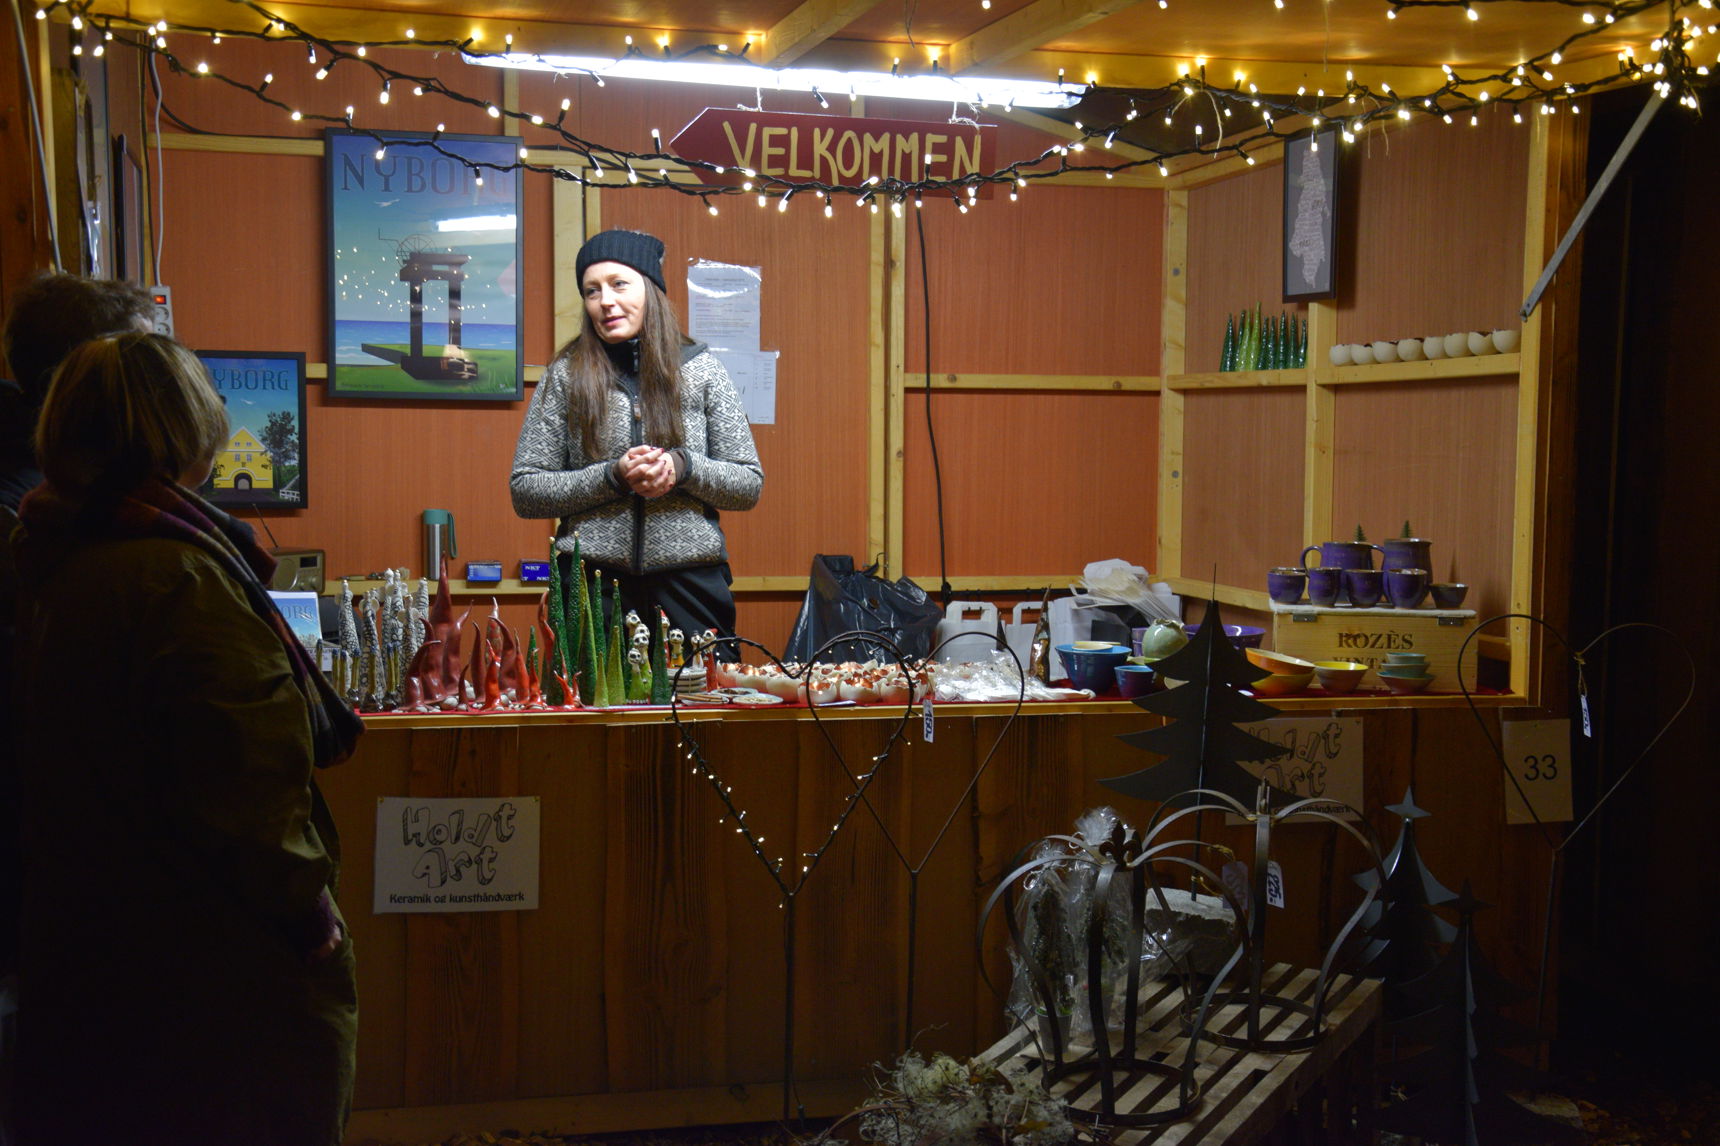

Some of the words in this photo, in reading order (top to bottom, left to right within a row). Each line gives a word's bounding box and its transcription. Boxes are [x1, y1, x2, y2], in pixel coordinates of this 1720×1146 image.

[722, 120, 982, 186] VELKOMMEN
[212, 367, 290, 391] YBORG
[1337, 630, 1414, 650] ROZÈS
[1524, 754, 1558, 781] 33
[402, 802, 517, 848] Holdt
[412, 845, 498, 889] Art
[389, 893, 432, 904] Keramik
[434, 894, 447, 904] og
[449, 891, 525, 904] kunsthåndværk
